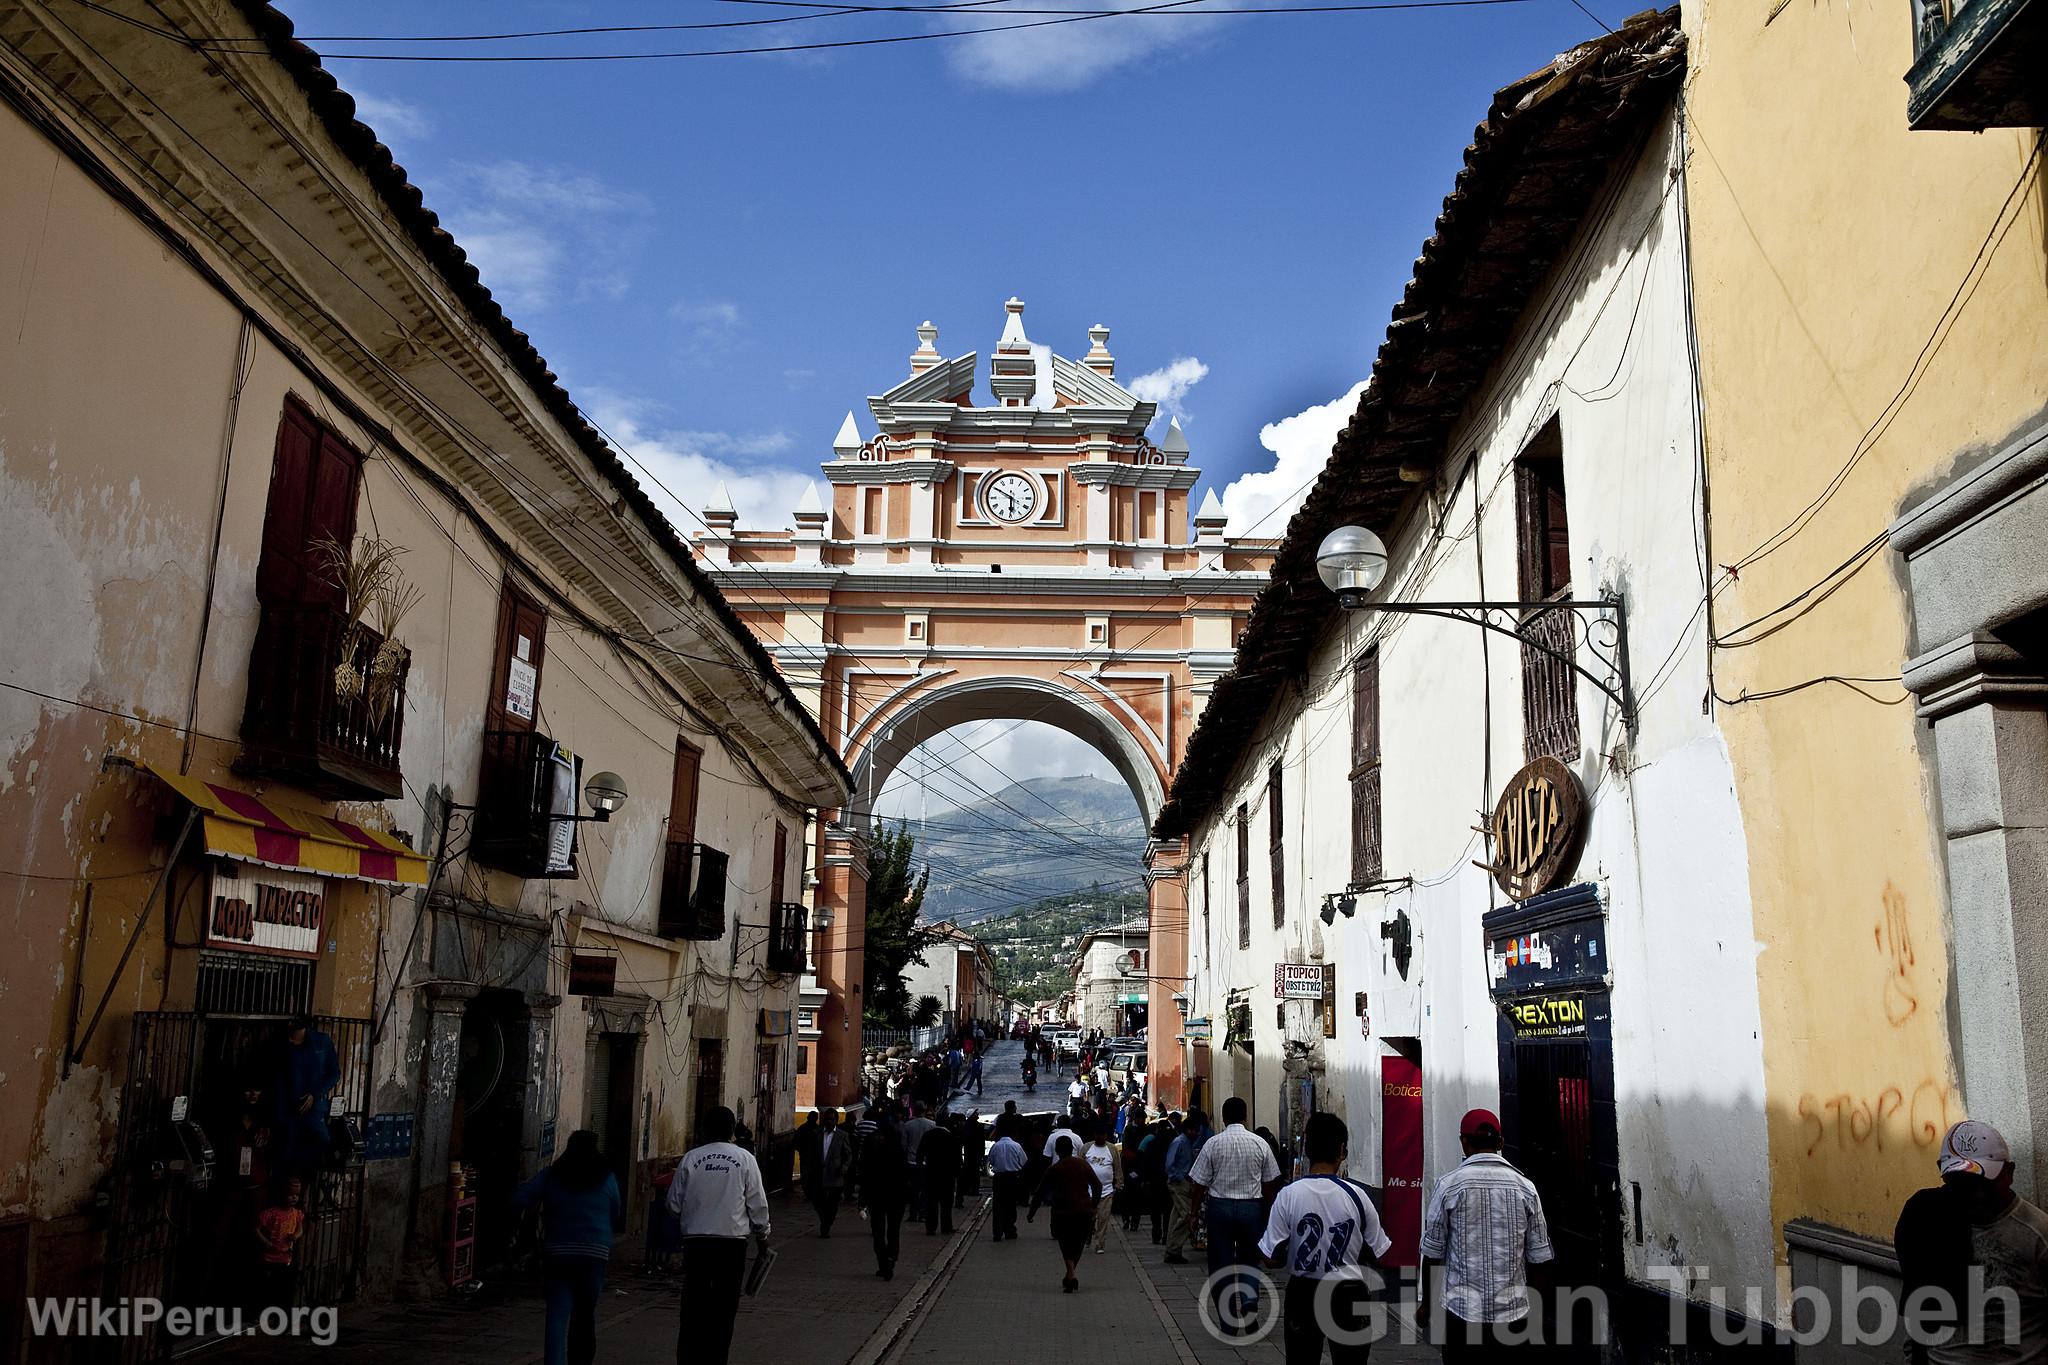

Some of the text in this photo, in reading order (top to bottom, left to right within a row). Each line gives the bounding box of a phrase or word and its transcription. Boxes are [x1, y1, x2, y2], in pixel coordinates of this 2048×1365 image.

[212, 883, 322, 942] MODA IMPACTO
[1286, 966, 1320, 980] TOPICO
[1511, 998, 1583, 1025] REXTON
[1798, 1086, 1902, 1157] STOP
[1387, 1177, 1407, 1187] Me
